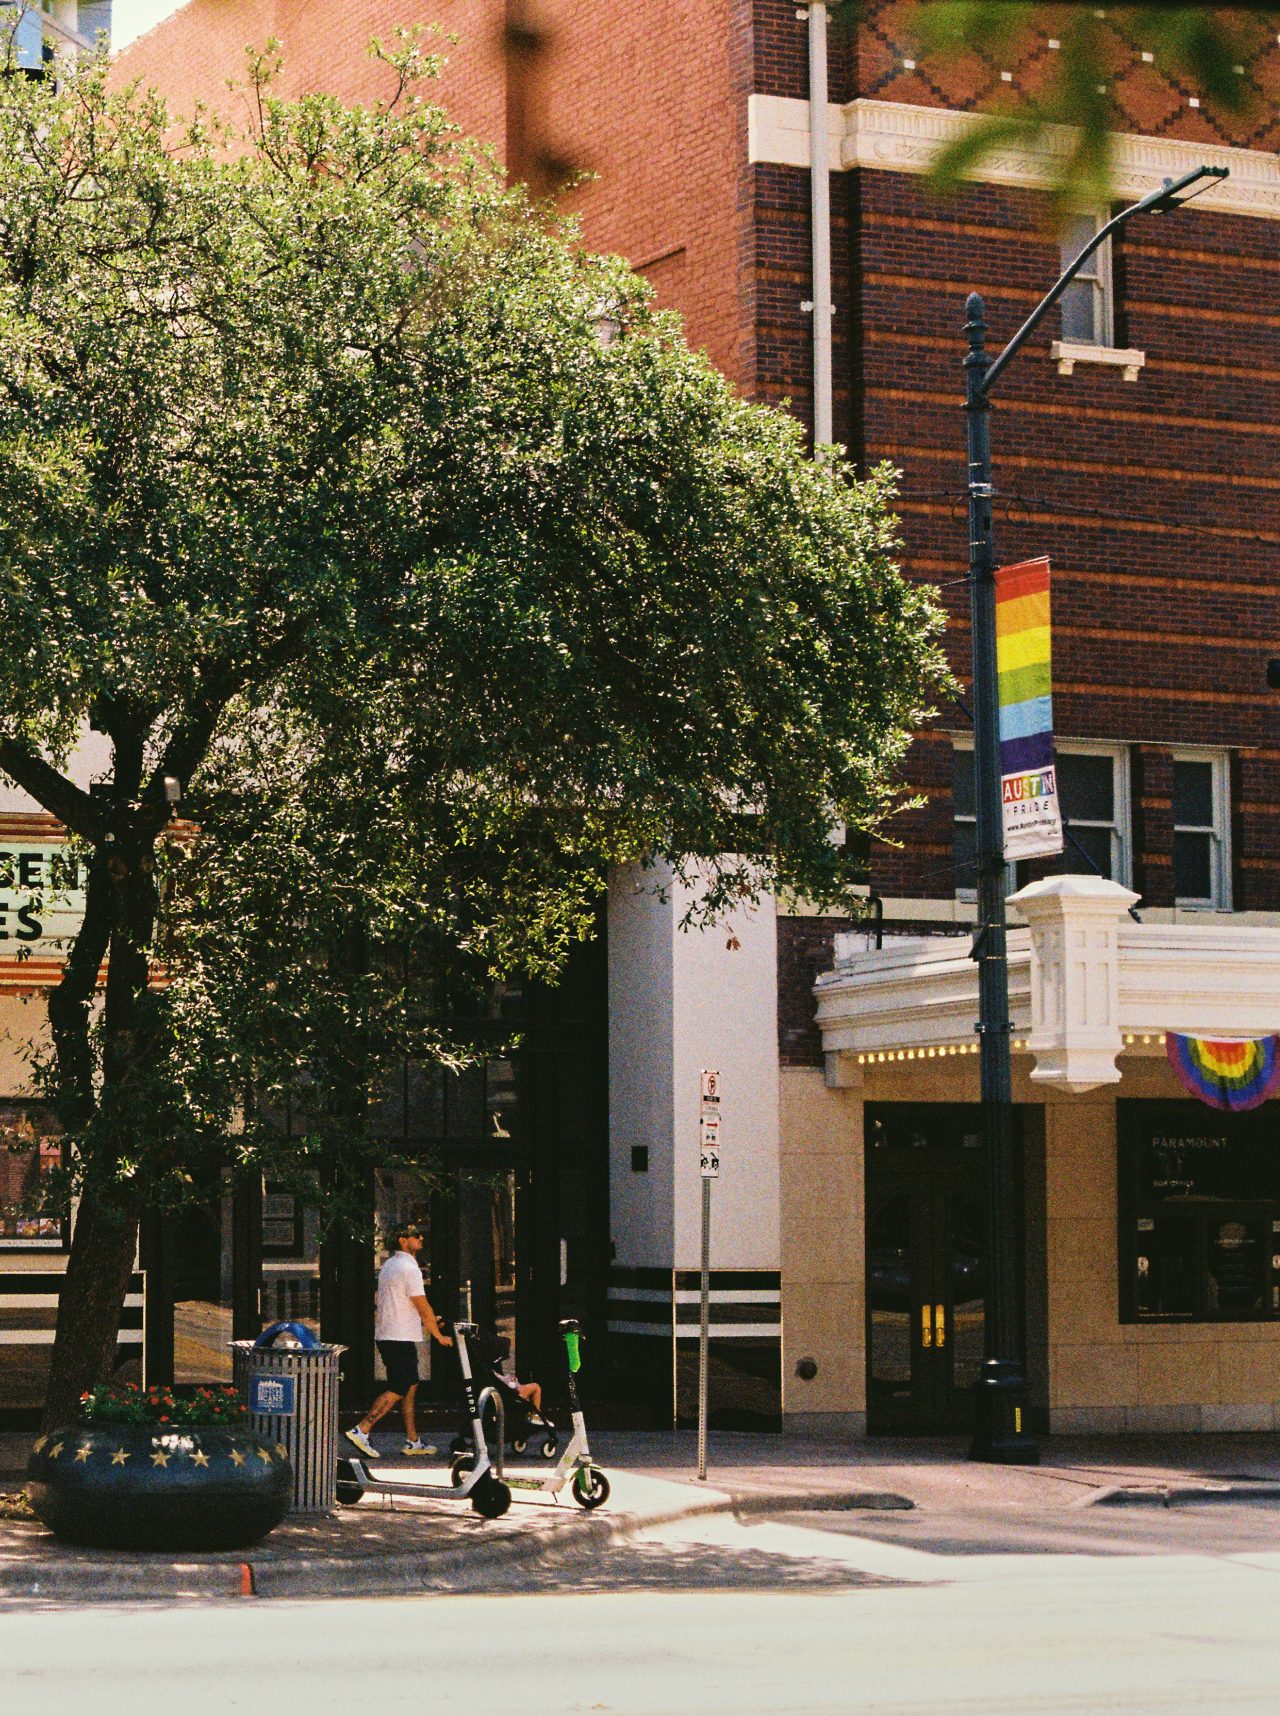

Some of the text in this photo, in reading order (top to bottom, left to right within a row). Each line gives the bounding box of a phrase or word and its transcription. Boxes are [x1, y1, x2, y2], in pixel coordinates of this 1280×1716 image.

[1004, 772, 1055, 801] AUSTIN
[1152, 1137, 1228, 1149] PARAMOUNT
[465, 1385, 476, 1413] BIRD
